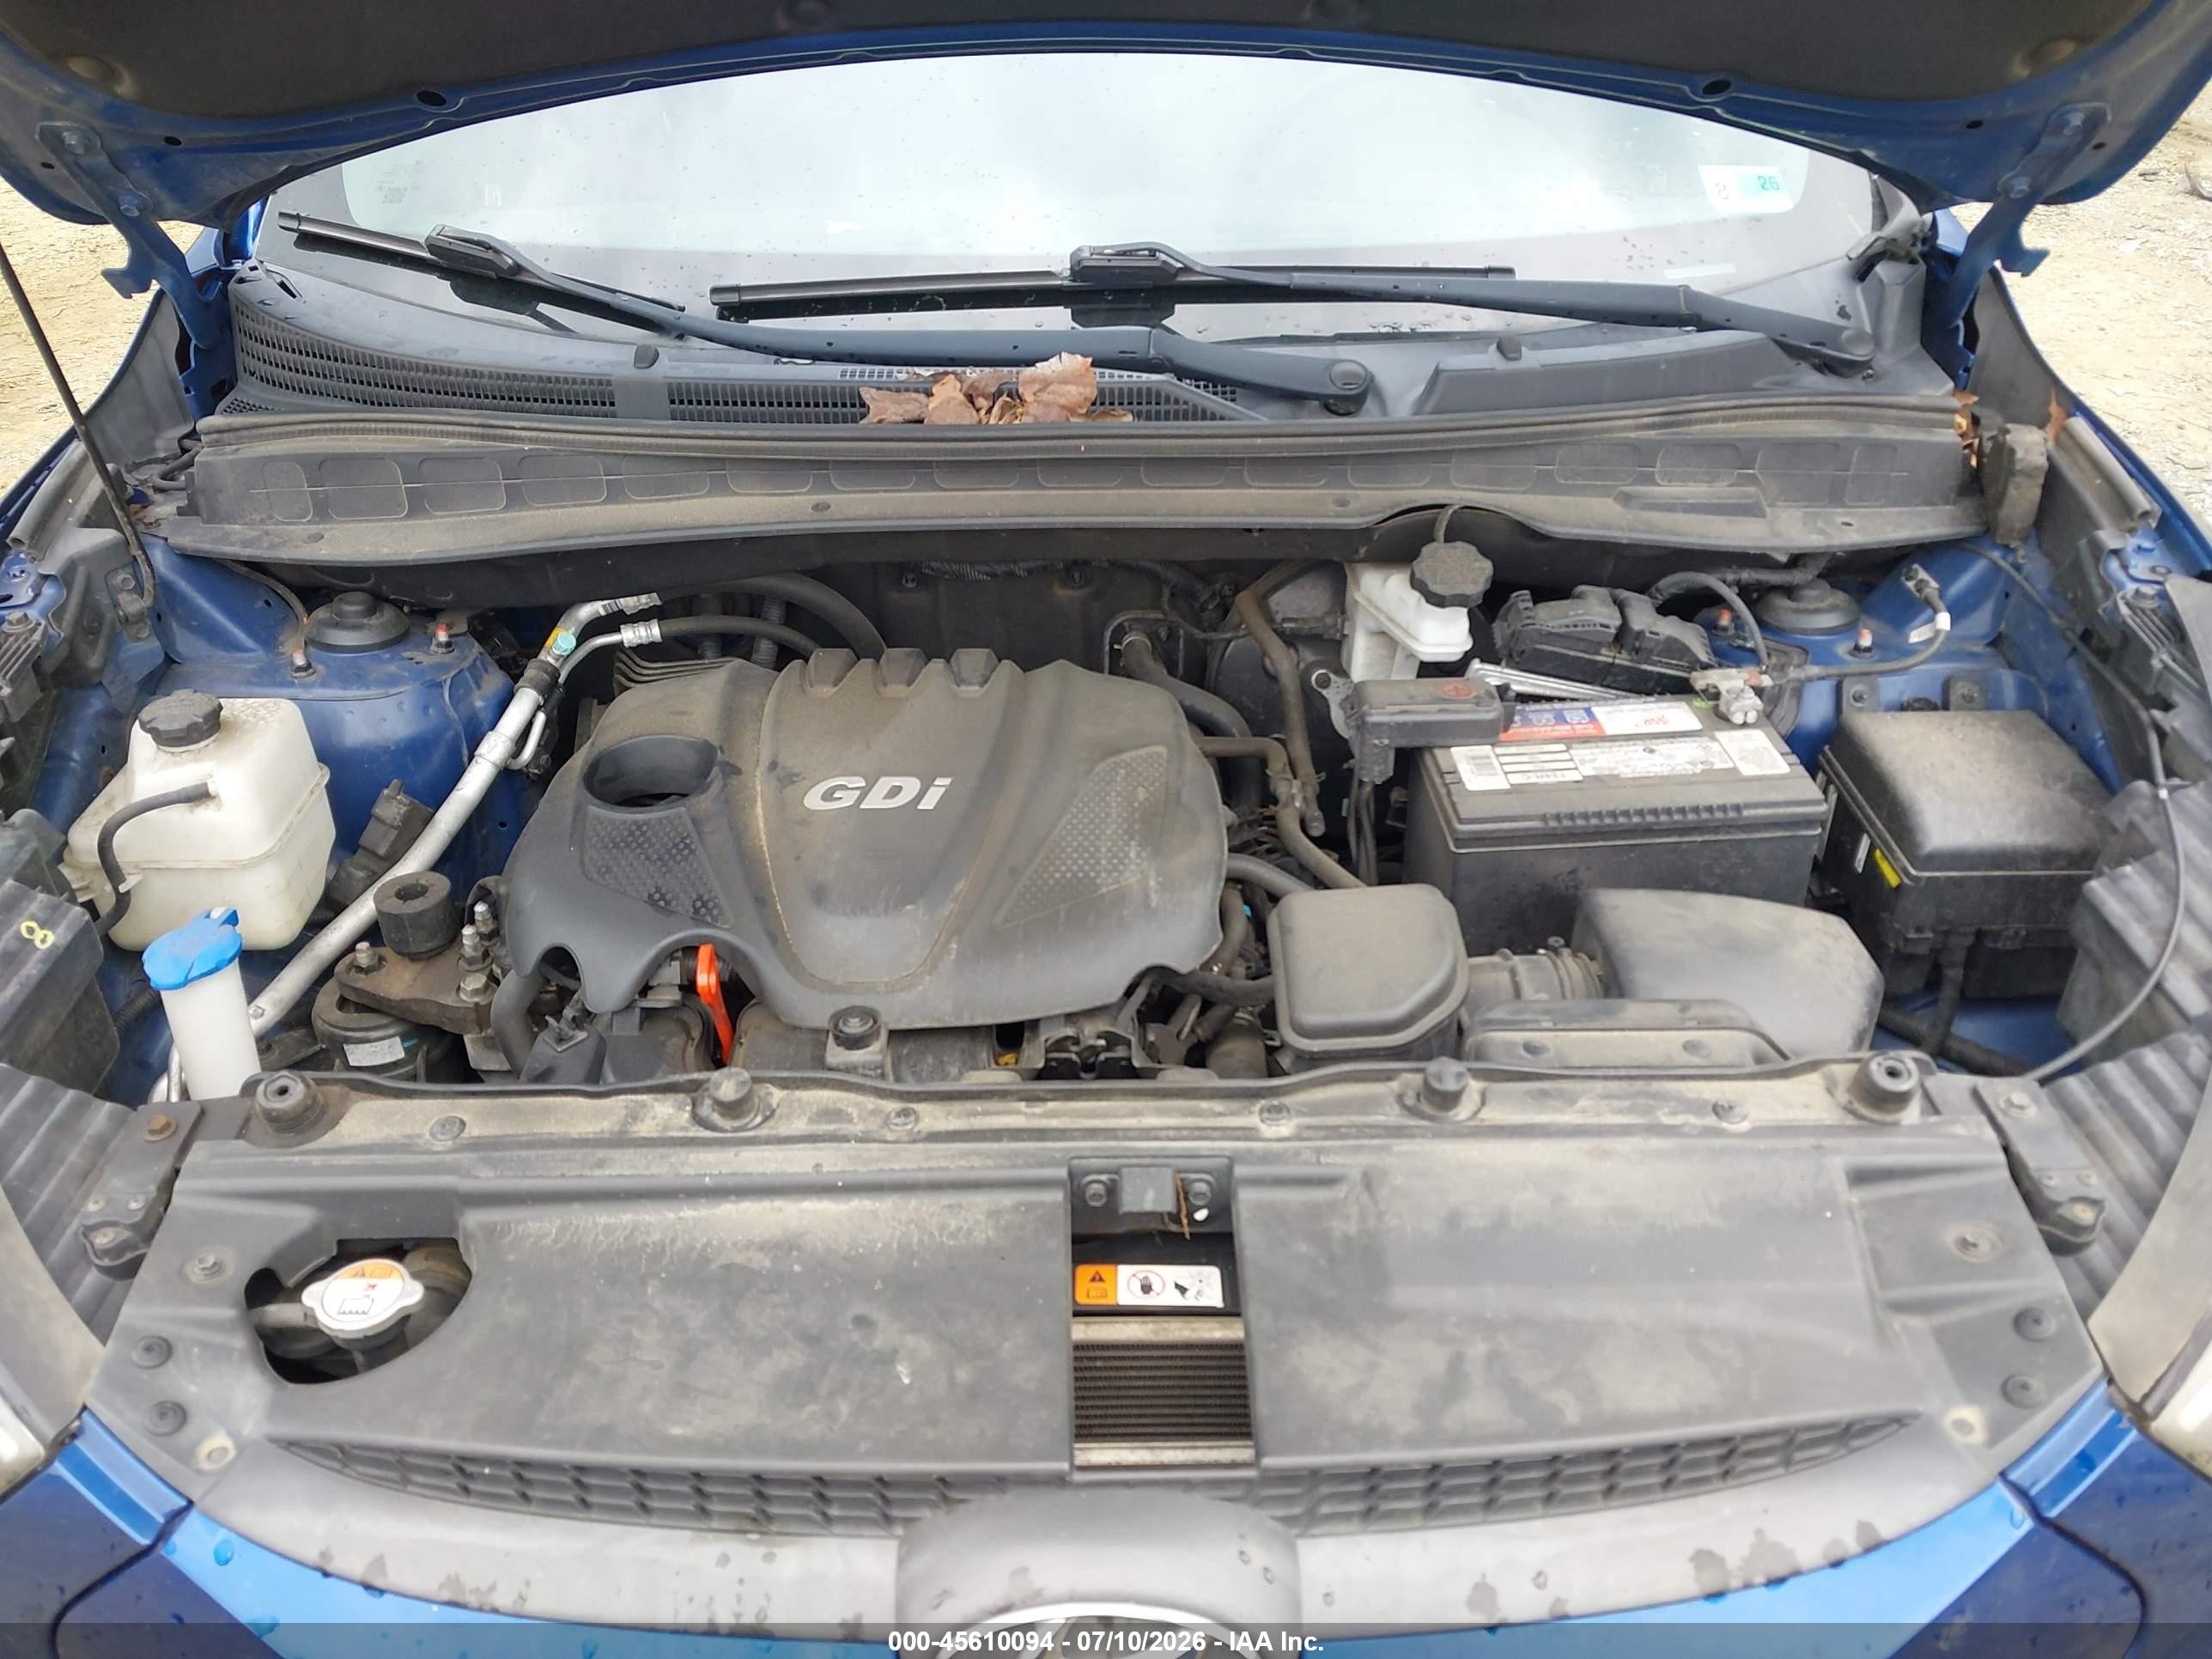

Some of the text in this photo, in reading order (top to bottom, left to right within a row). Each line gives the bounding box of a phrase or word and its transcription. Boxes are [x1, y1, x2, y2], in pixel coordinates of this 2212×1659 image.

[1757, 175, 1780, 191] 26
[803, 776, 953, 810] GDi
[20, 920, 55, 950] 8
